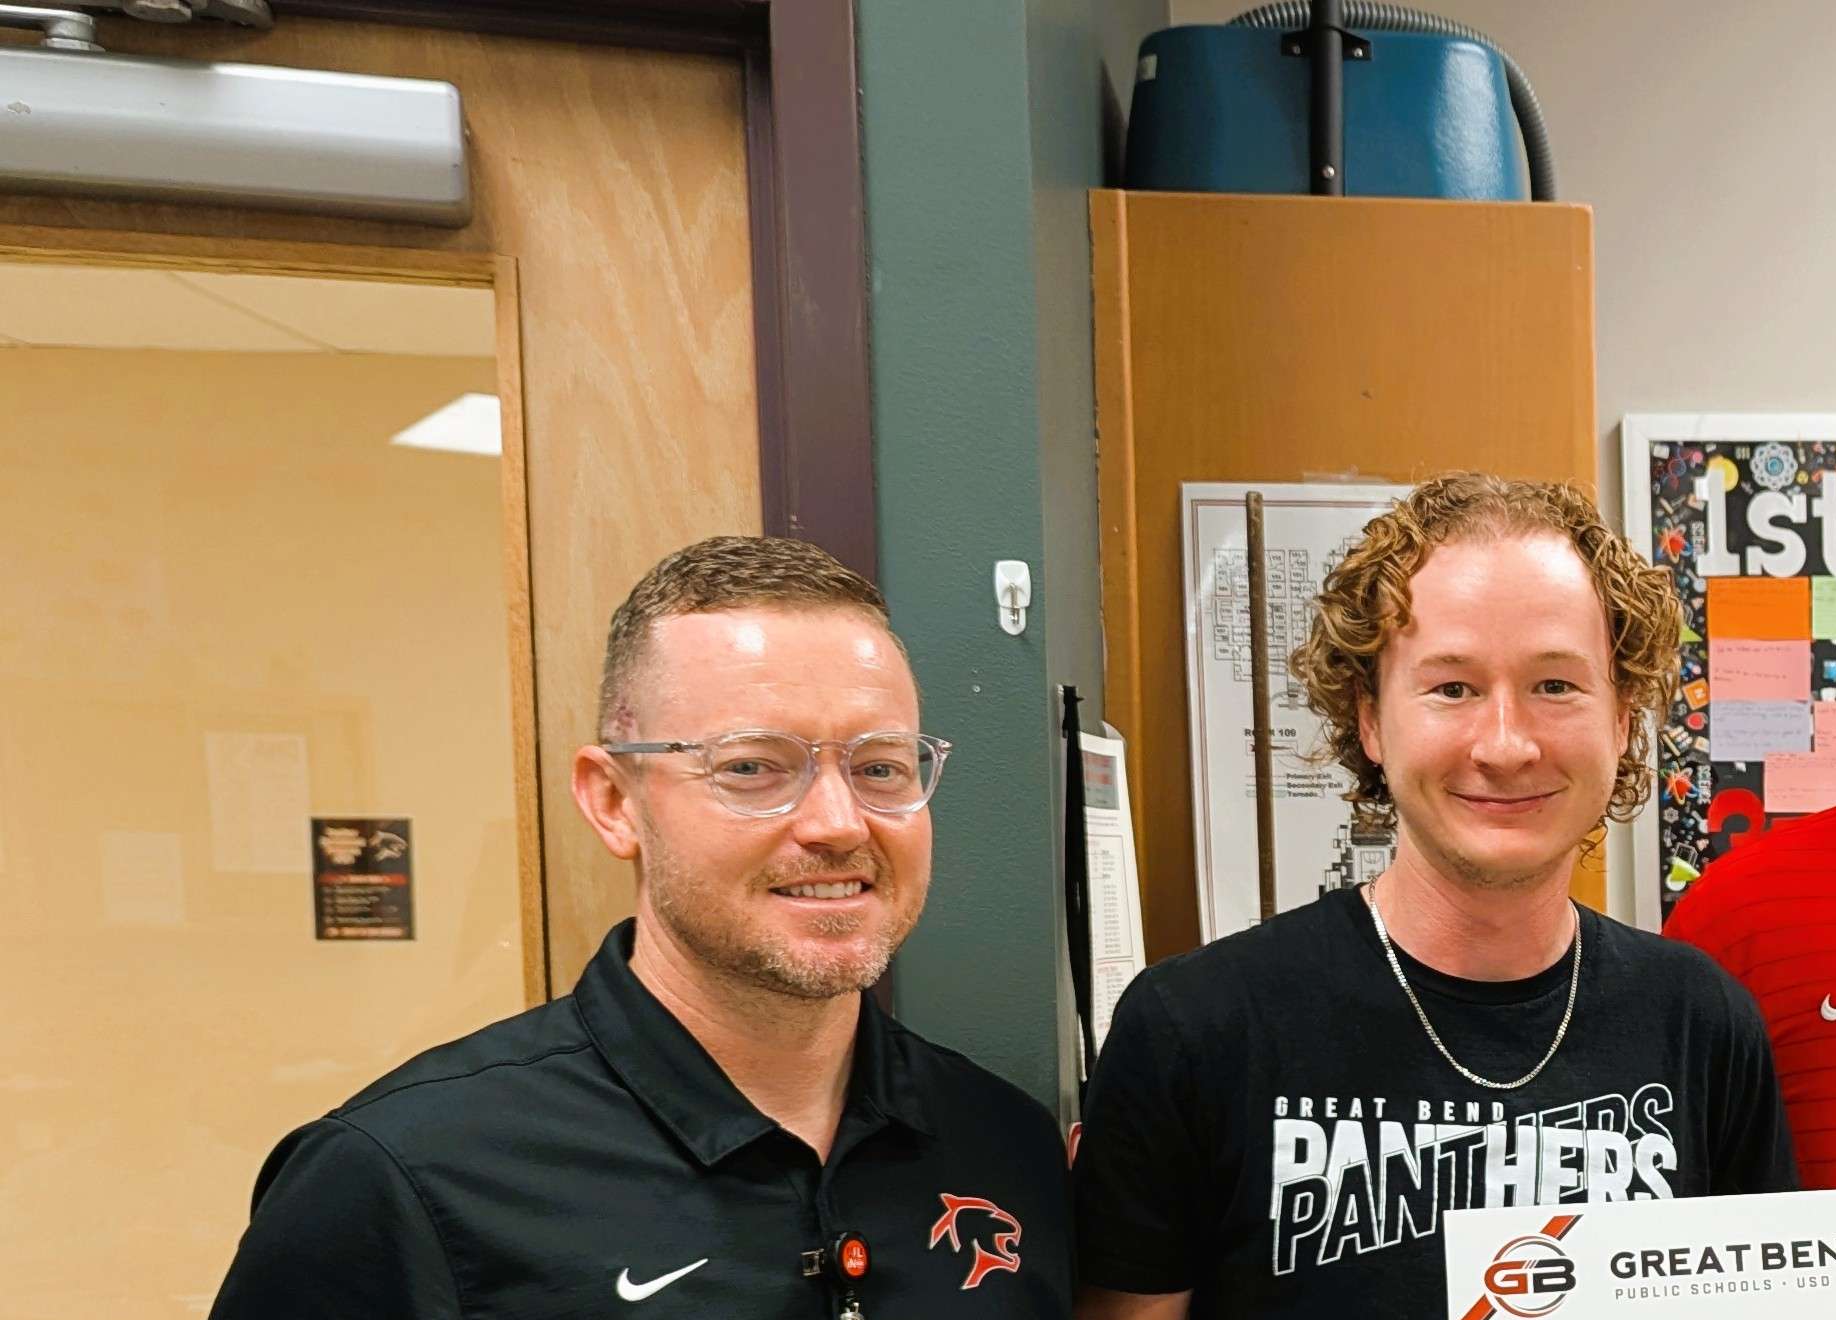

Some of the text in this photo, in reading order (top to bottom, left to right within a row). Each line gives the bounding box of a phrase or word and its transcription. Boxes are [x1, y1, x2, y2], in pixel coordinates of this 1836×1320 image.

[1274, 1096, 1504, 1122] GREAT BEND
[1484, 1257, 1577, 1295] GB
[1610, 1244, 1751, 1280] GREAT
[1615, 1284, 1681, 1300] PUBLIC
[1690, 1278, 1773, 1296] SCHOOLS
[1796, 1275, 1831, 1290] USD
